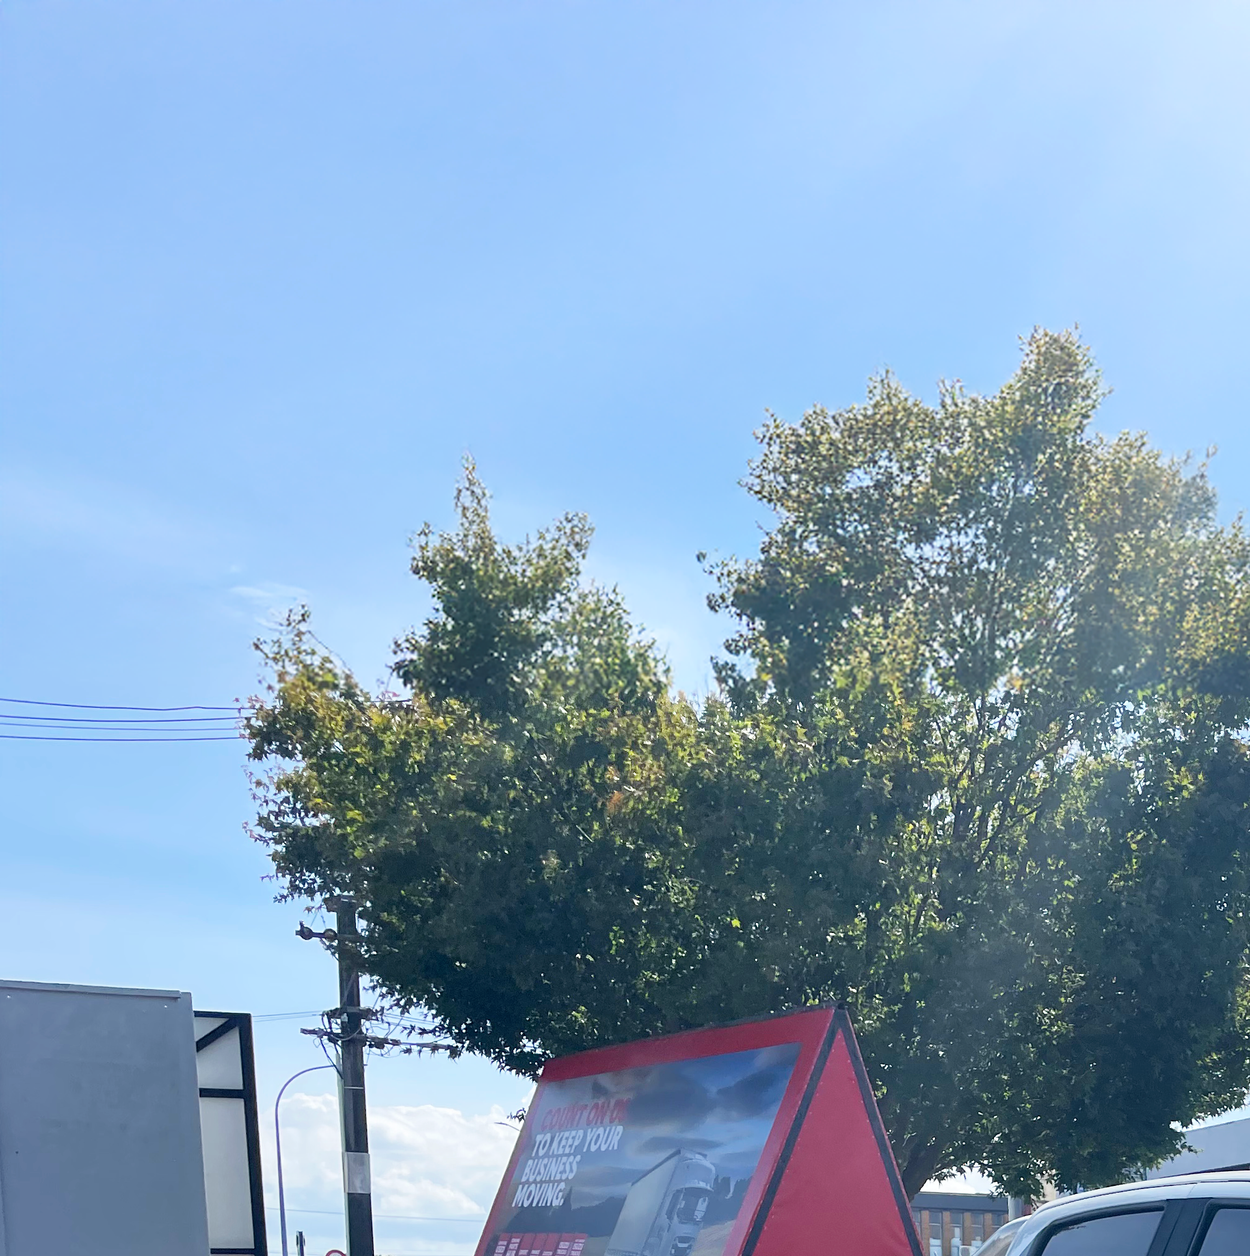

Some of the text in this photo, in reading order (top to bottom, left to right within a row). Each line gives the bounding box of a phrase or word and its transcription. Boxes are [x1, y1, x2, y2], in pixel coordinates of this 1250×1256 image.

[532, 1126, 623, 1156] TO KEEP YOUR
[521, 1155, 581, 1182] BUSINESS
[512, 1182, 566, 1207] MOVING.
